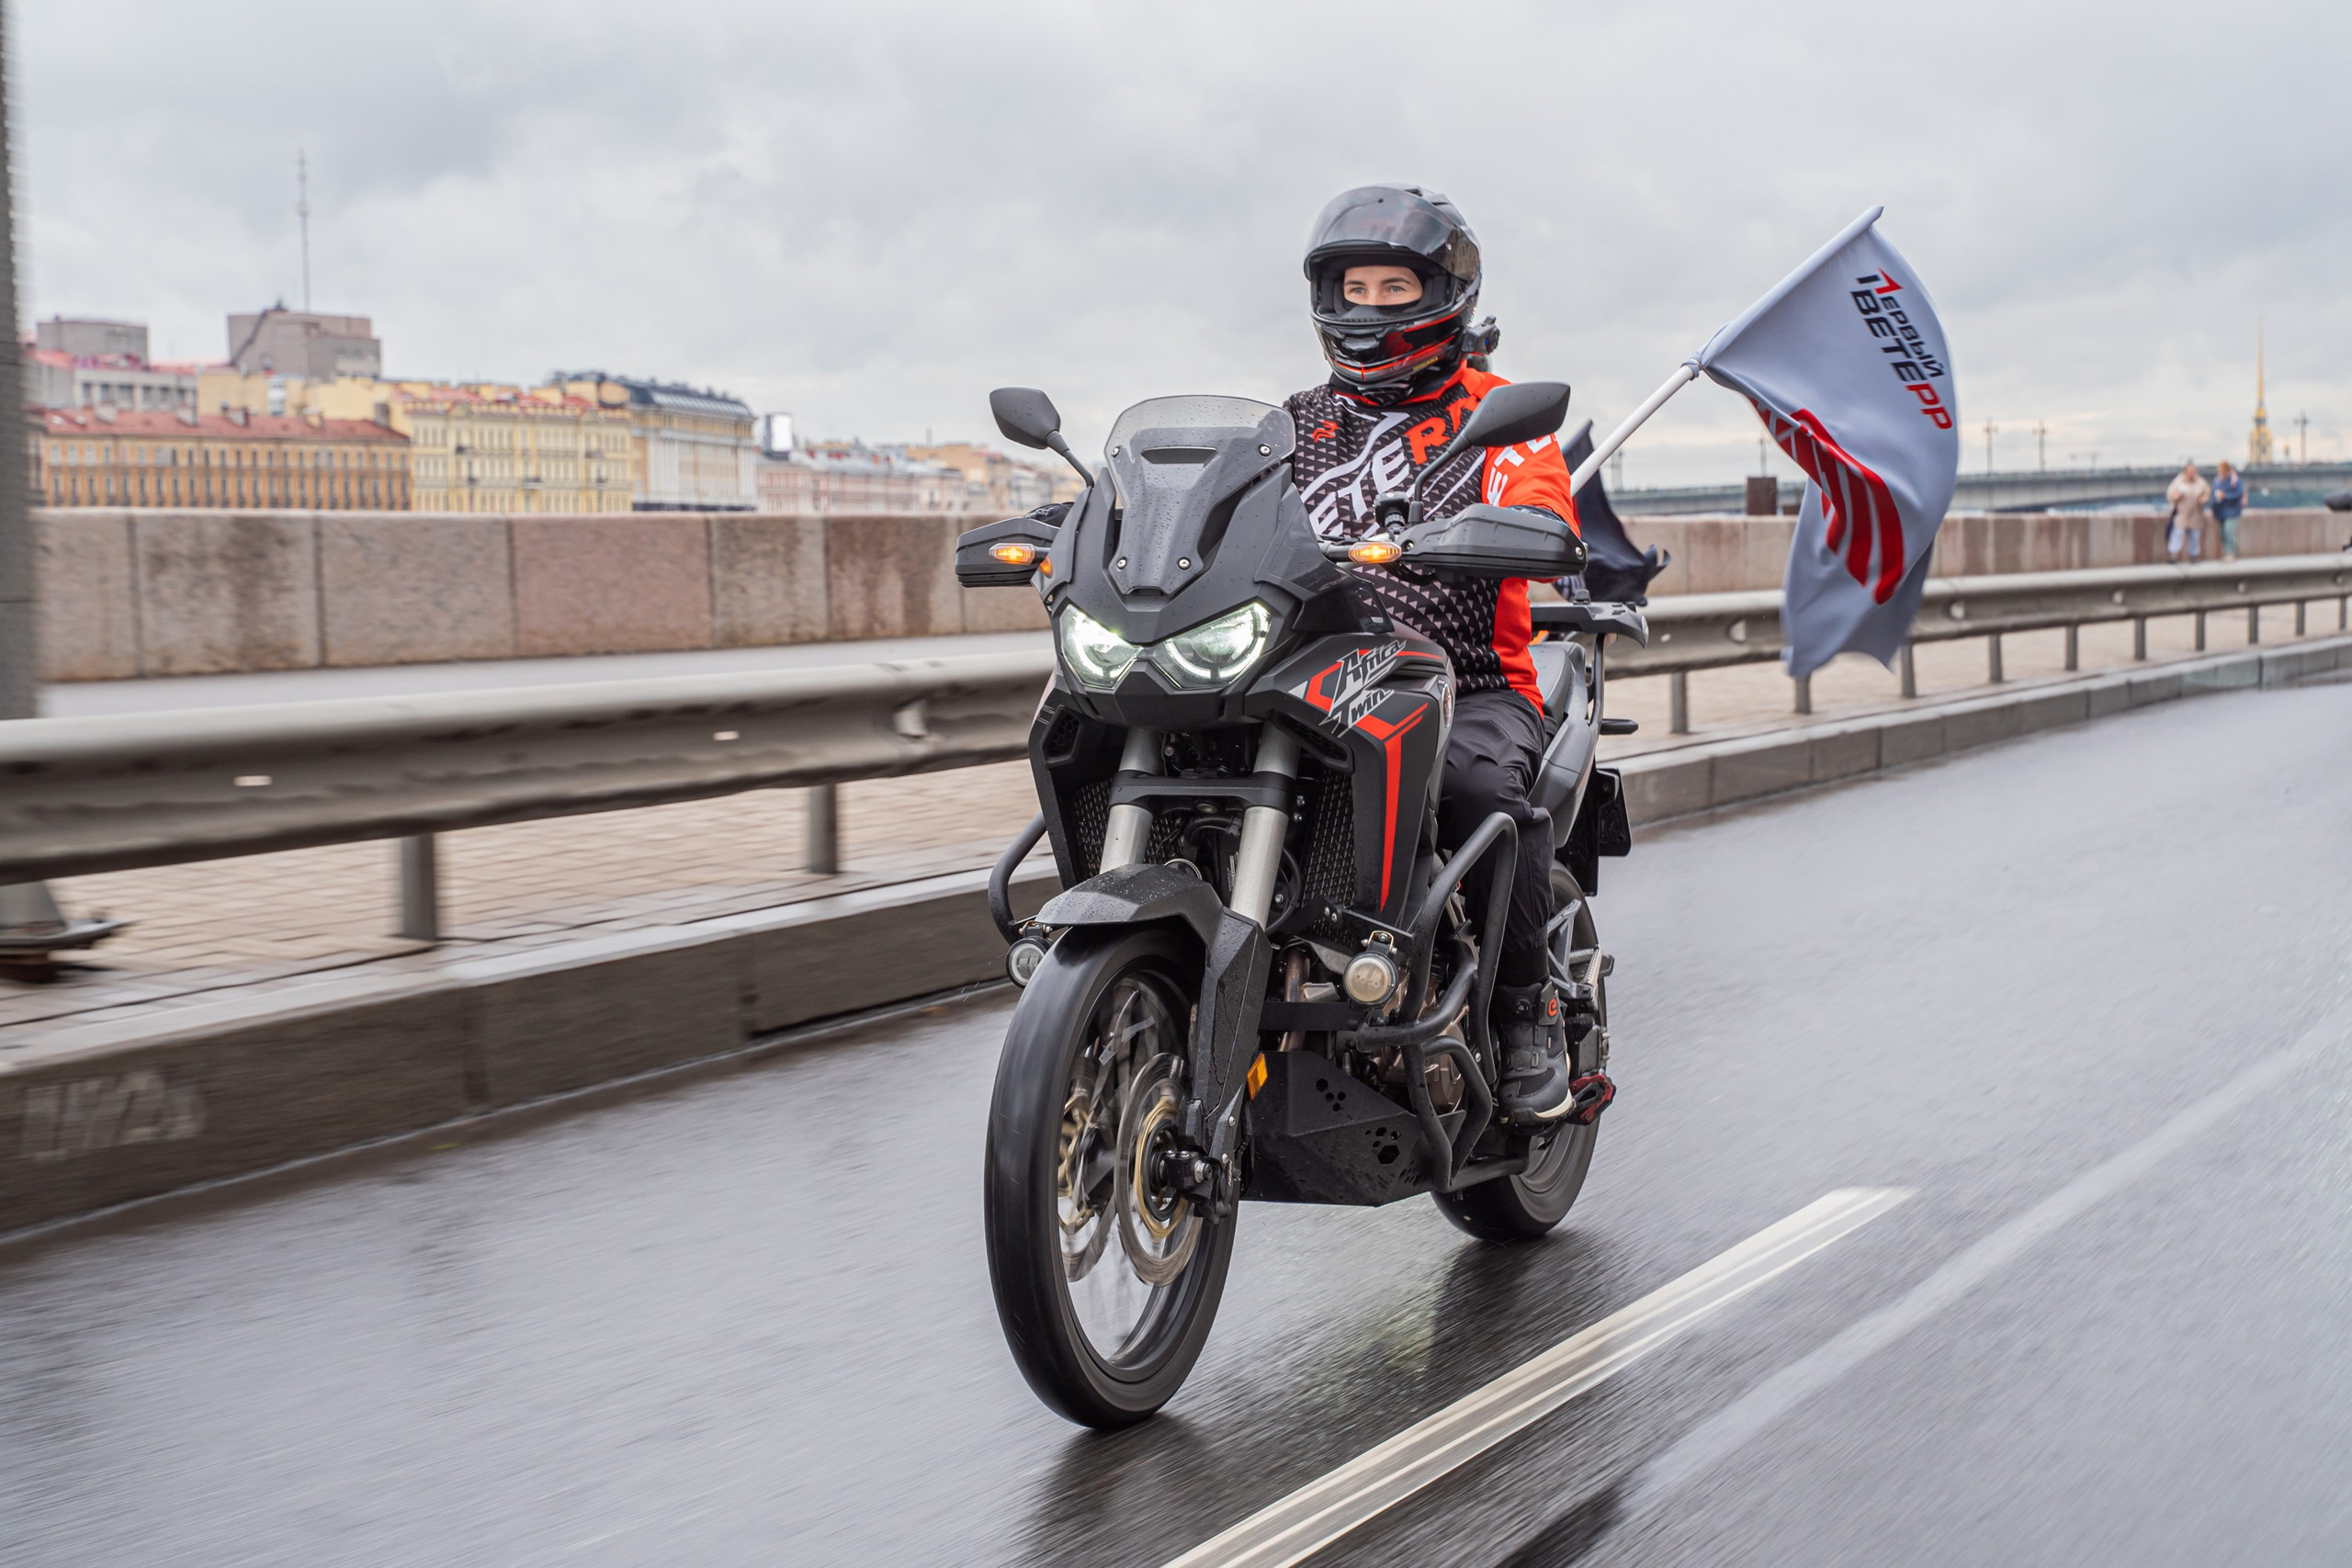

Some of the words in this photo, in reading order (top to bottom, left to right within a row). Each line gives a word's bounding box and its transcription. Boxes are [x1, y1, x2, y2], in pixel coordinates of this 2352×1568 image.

[1849, 289, 1953, 430] ВЕТЕРР
[1329, 639, 1407, 705] Africa
[1319, 682, 1396, 737] Twin
